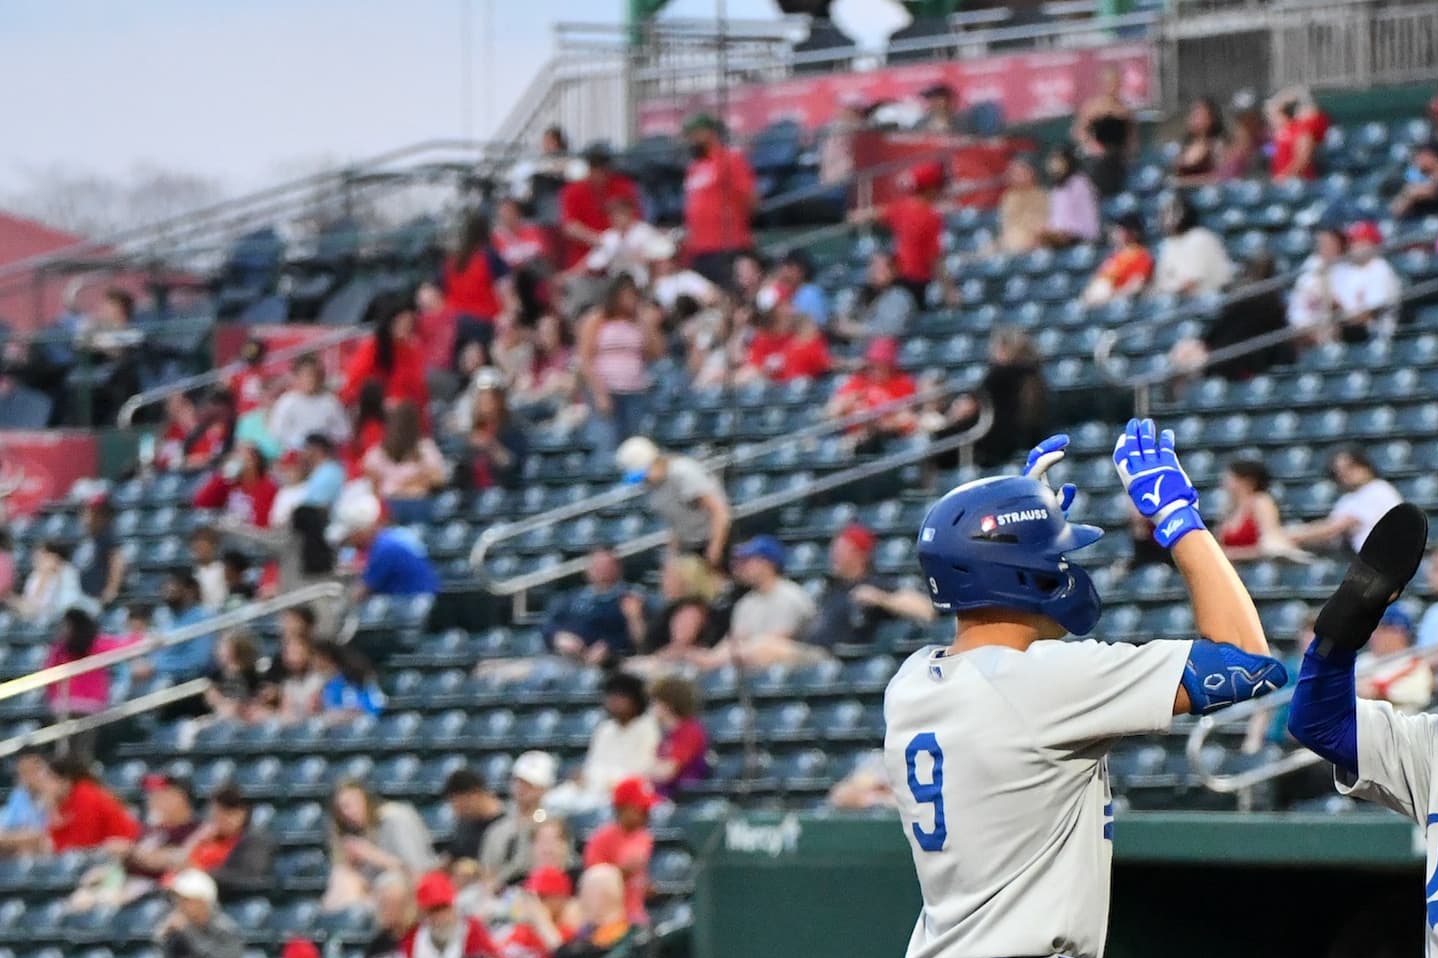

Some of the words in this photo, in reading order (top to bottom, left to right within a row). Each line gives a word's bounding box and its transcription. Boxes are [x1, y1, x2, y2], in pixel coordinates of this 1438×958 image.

[996, 508, 1049, 526] STRAUSS
[929, 576, 939, 595] 9
[905, 732, 947, 852] 9
